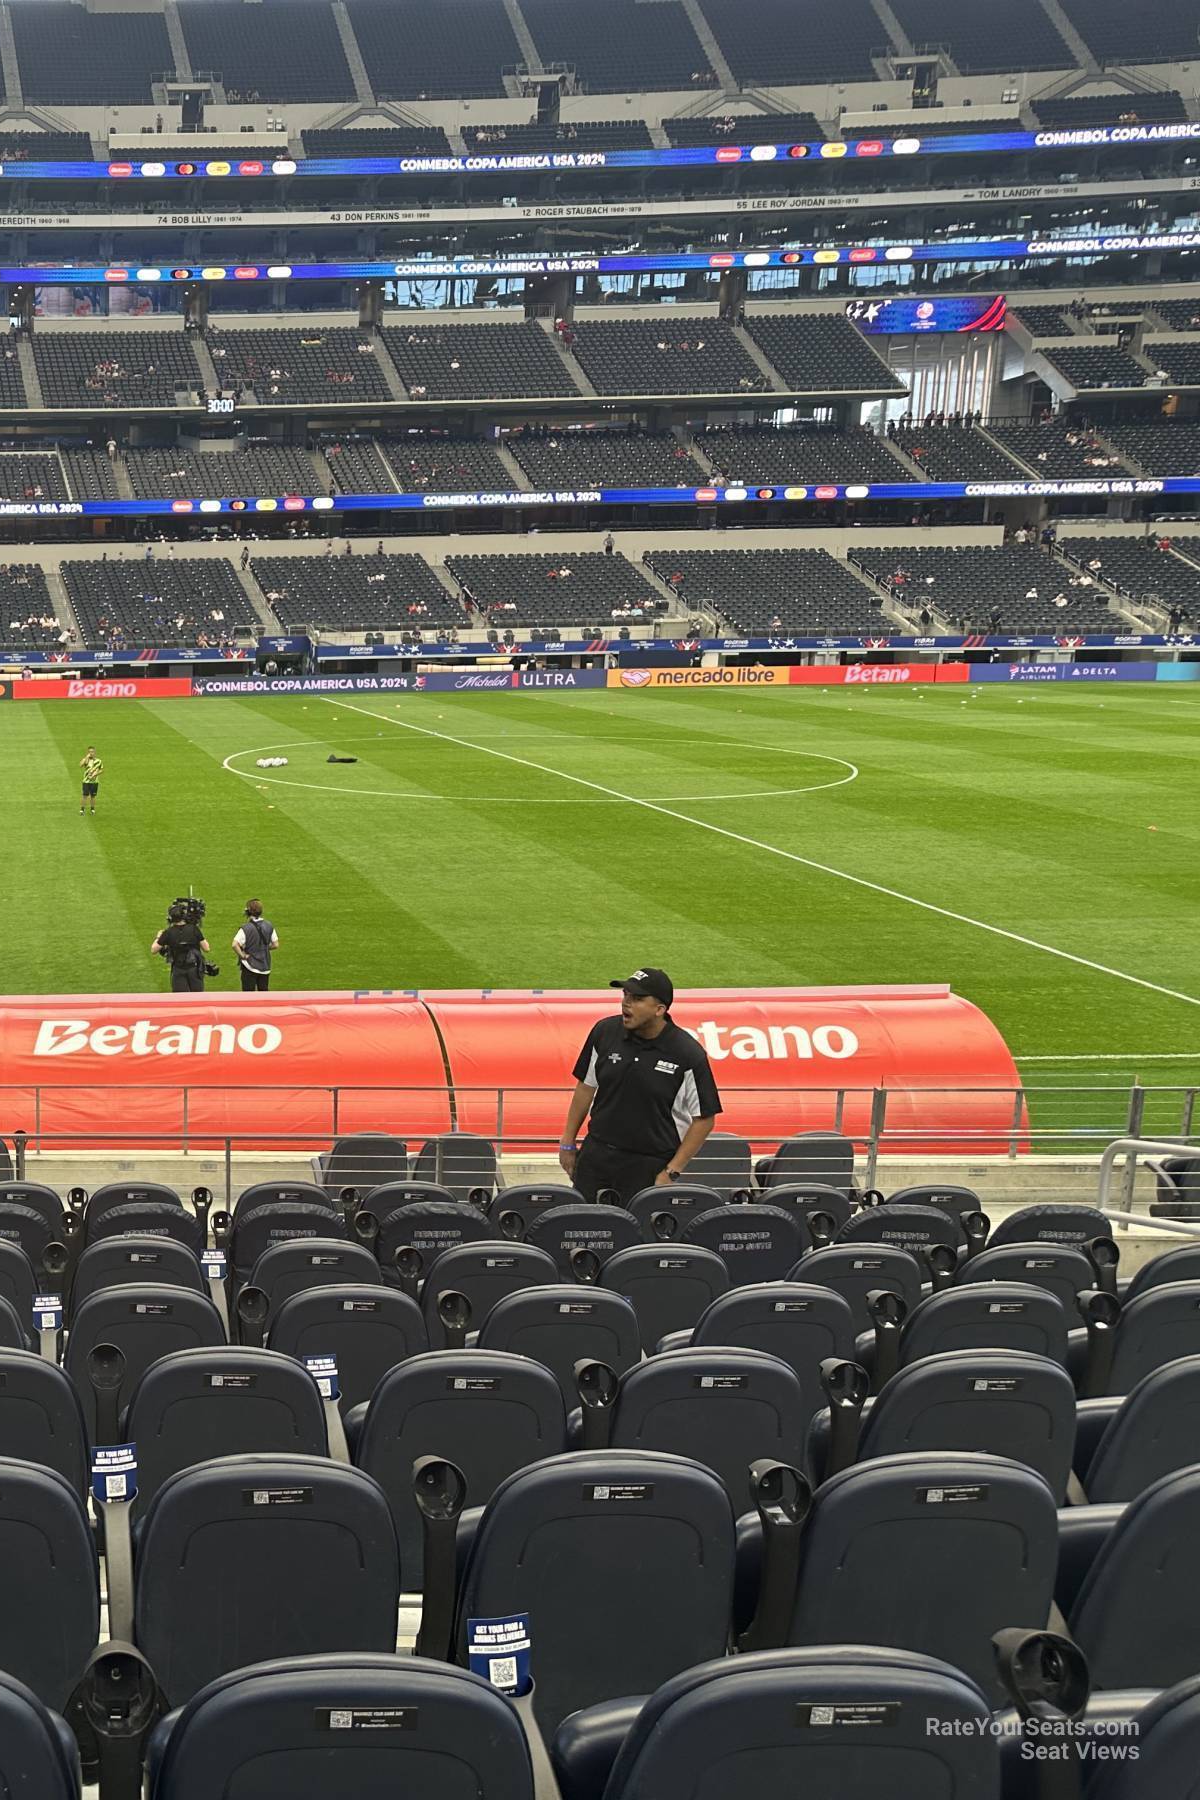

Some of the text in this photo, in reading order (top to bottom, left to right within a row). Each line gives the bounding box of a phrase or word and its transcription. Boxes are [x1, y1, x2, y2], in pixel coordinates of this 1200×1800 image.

[1035, 124, 1200, 146] CONMEBOL COPA AMERIC
[400, 154, 605, 171] CONMEBOL COPA AMERICA USA 2024
[978, 190, 1000, 198] TOM
[1002, 187, 1042, 197] LANDRY
[522, 208, 532, 216] 12
[535, 207, 563, 215] ROGER
[566, 206, 608, 215] STAUBACH
[736, 201, 748, 209] 55
[752, 200, 770, 208] LEE
[771, 199, 787, 208] ROY
[789, 198, 825, 207] JORDAN
[157, 216, 168, 224] 74
[171, 216, 189, 224] BOB
[190, 215, 212, 224] LILLY
[330, 212, 342, 220] 43
[345, 212, 364, 220] DON
[365, 212, 400, 220] PERKINS
[1028, 234, 1200, 253] CONMEBOL COPA AMERICA
[395, 260, 599, 275] CONMEBOL COPA AMERICA USA 2024
[208, 399, 234, 413] 30:00
[965, 480, 1163, 496] CONMEBOL COPA AMERICA USA 2024
[423, 491, 601, 506] CONMEBOL COPA AMERICA USA 2024
[40, 504, 58, 514] USA
[60, 504, 83, 514] 2024
[657, 667, 774, 684] mercado libre
[844, 666, 910, 683] Betano
[1020, 665, 1056, 674] LATAM
[1082, 667, 1117, 675] DELTA
[206, 677, 408, 692] CONMEBOL COPA AMERICA USA 2024
[455, 672, 508, 689] Michelob
[523, 672, 575, 686] ULTRA
[68, 682, 137, 697] Betano
[33, 1020, 282, 1056] Betano
[684, 1021, 859, 1060] tano
